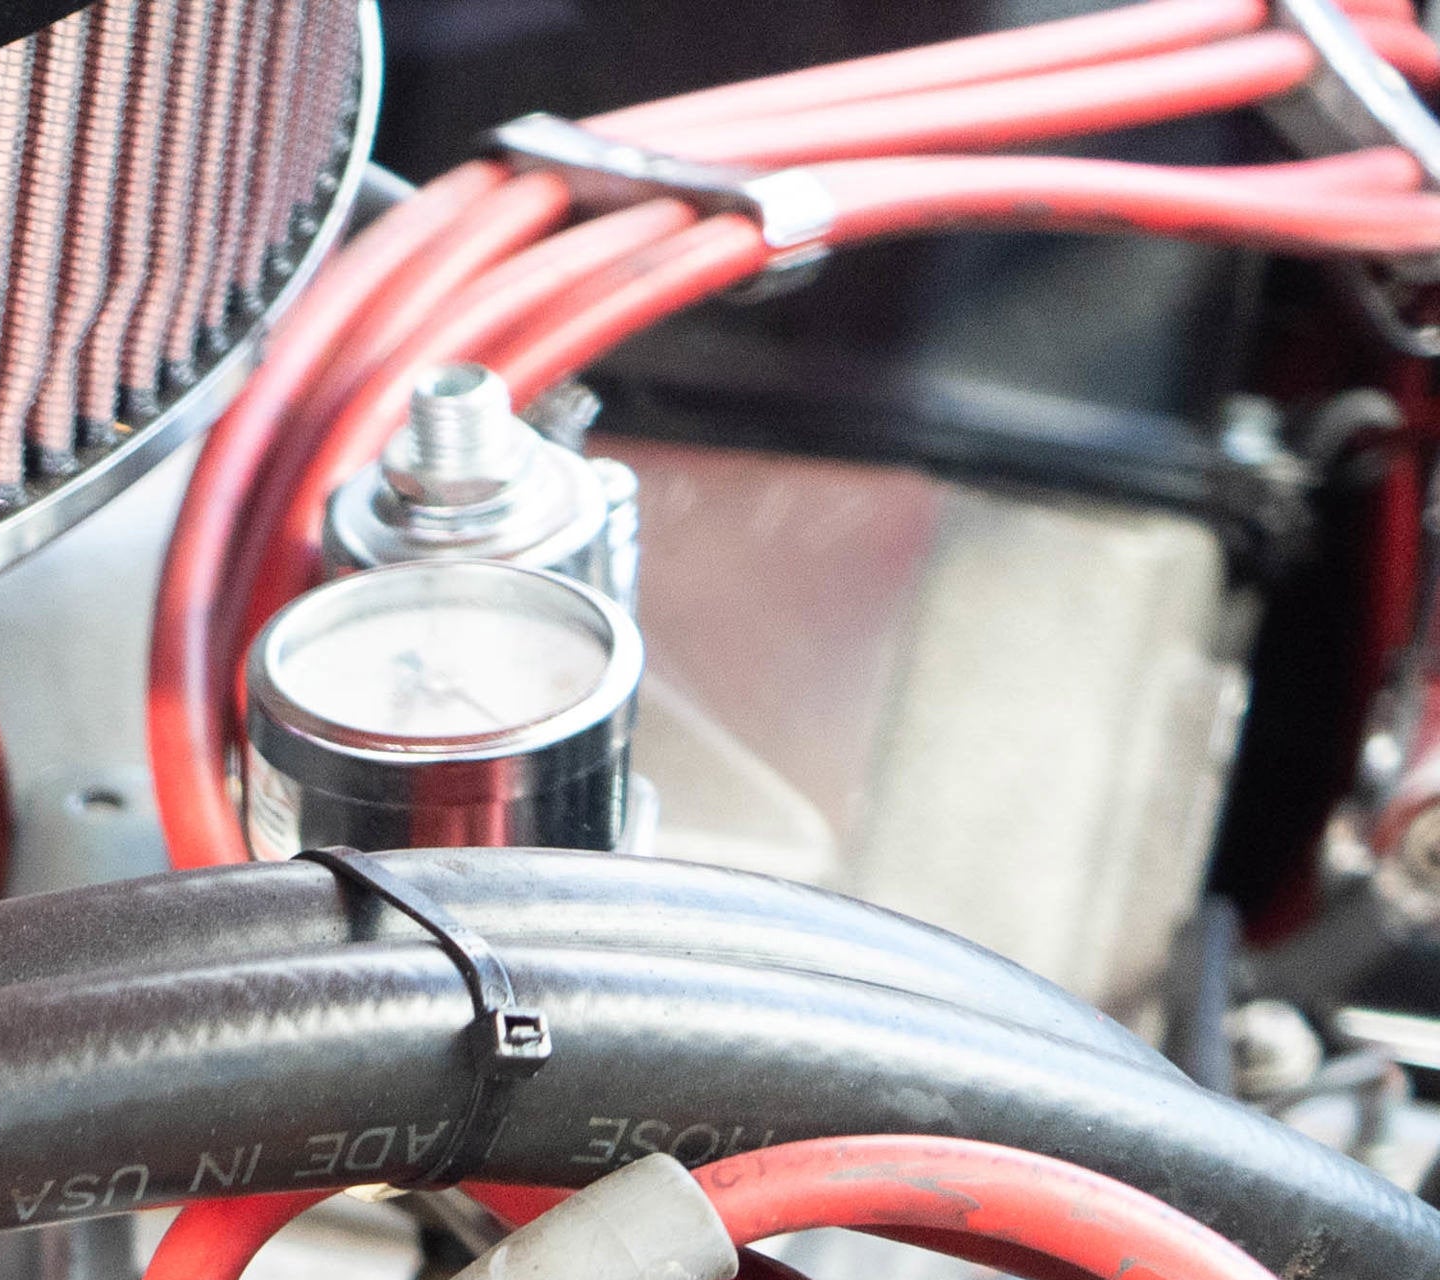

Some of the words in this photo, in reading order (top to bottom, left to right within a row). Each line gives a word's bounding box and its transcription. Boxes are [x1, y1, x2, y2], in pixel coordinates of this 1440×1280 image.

[188, 1143, 263, 1193] IN
[295, 1115, 507, 1178] ADE
[9, 1163, 150, 1222] USA
